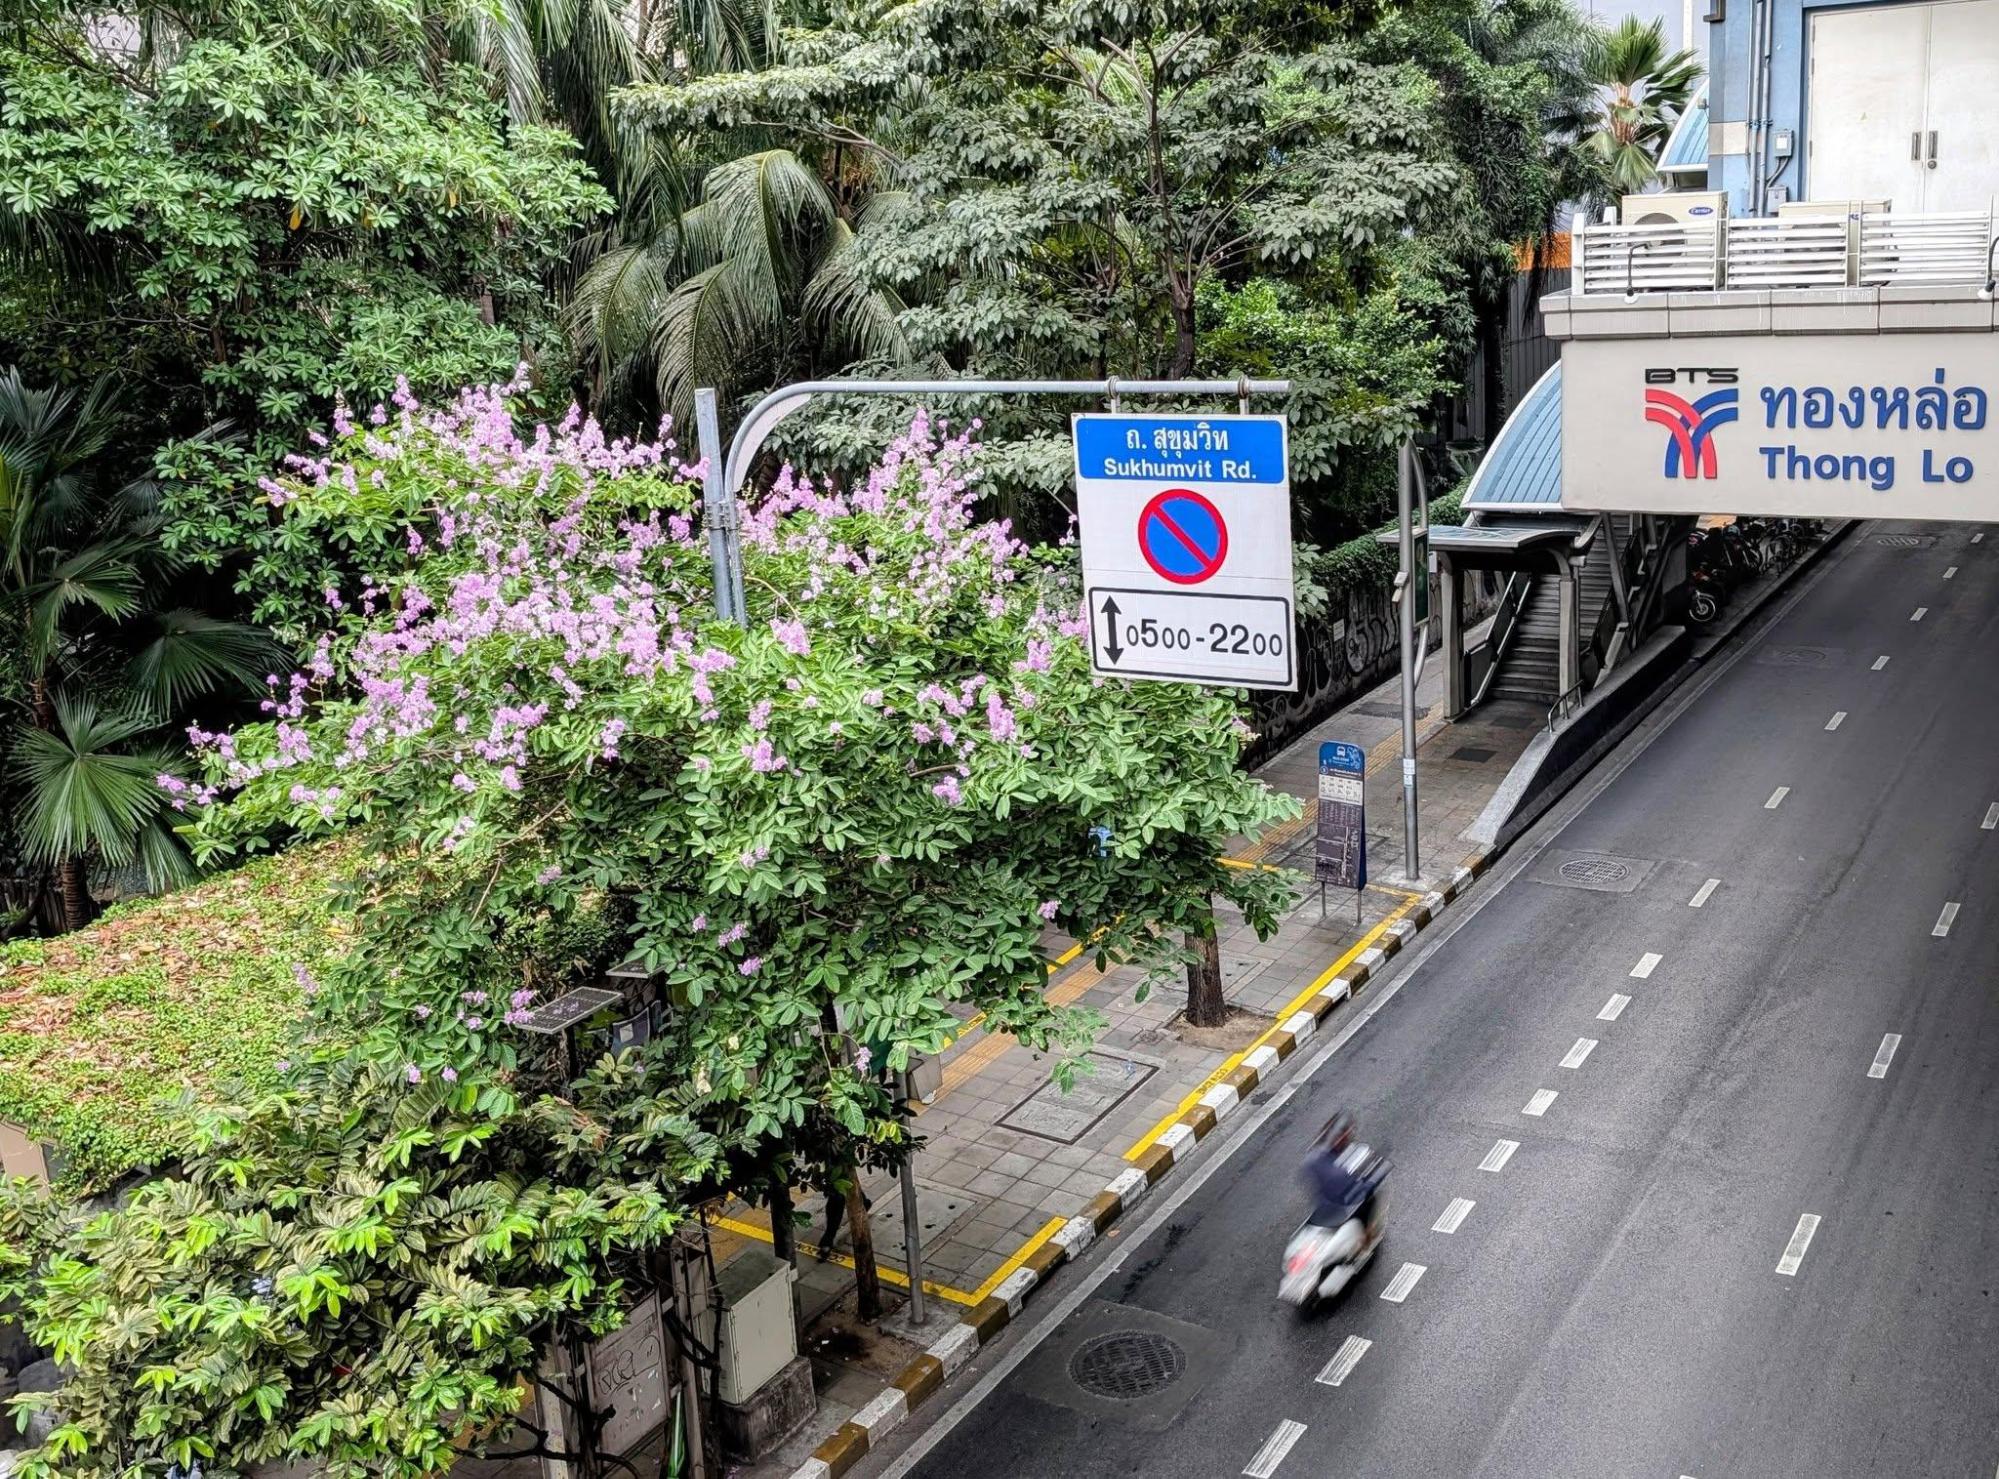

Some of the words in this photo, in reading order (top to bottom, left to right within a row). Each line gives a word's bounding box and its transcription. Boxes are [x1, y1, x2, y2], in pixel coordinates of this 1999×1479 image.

[1645, 368, 1739, 384] BTS
[1760, 368, 1987, 430] ทองหล่อ
[1127, 429, 1147, 449] ถ.
[1153, 422, 1229, 458] สุขุมวิท
[1104, 457, 1212, 478] Sukhumvit
[1222, 460, 1257, 479] Rd.
[1760, 446, 1895, 490] Thong
[1922, 449, 1974, 482] Lo
